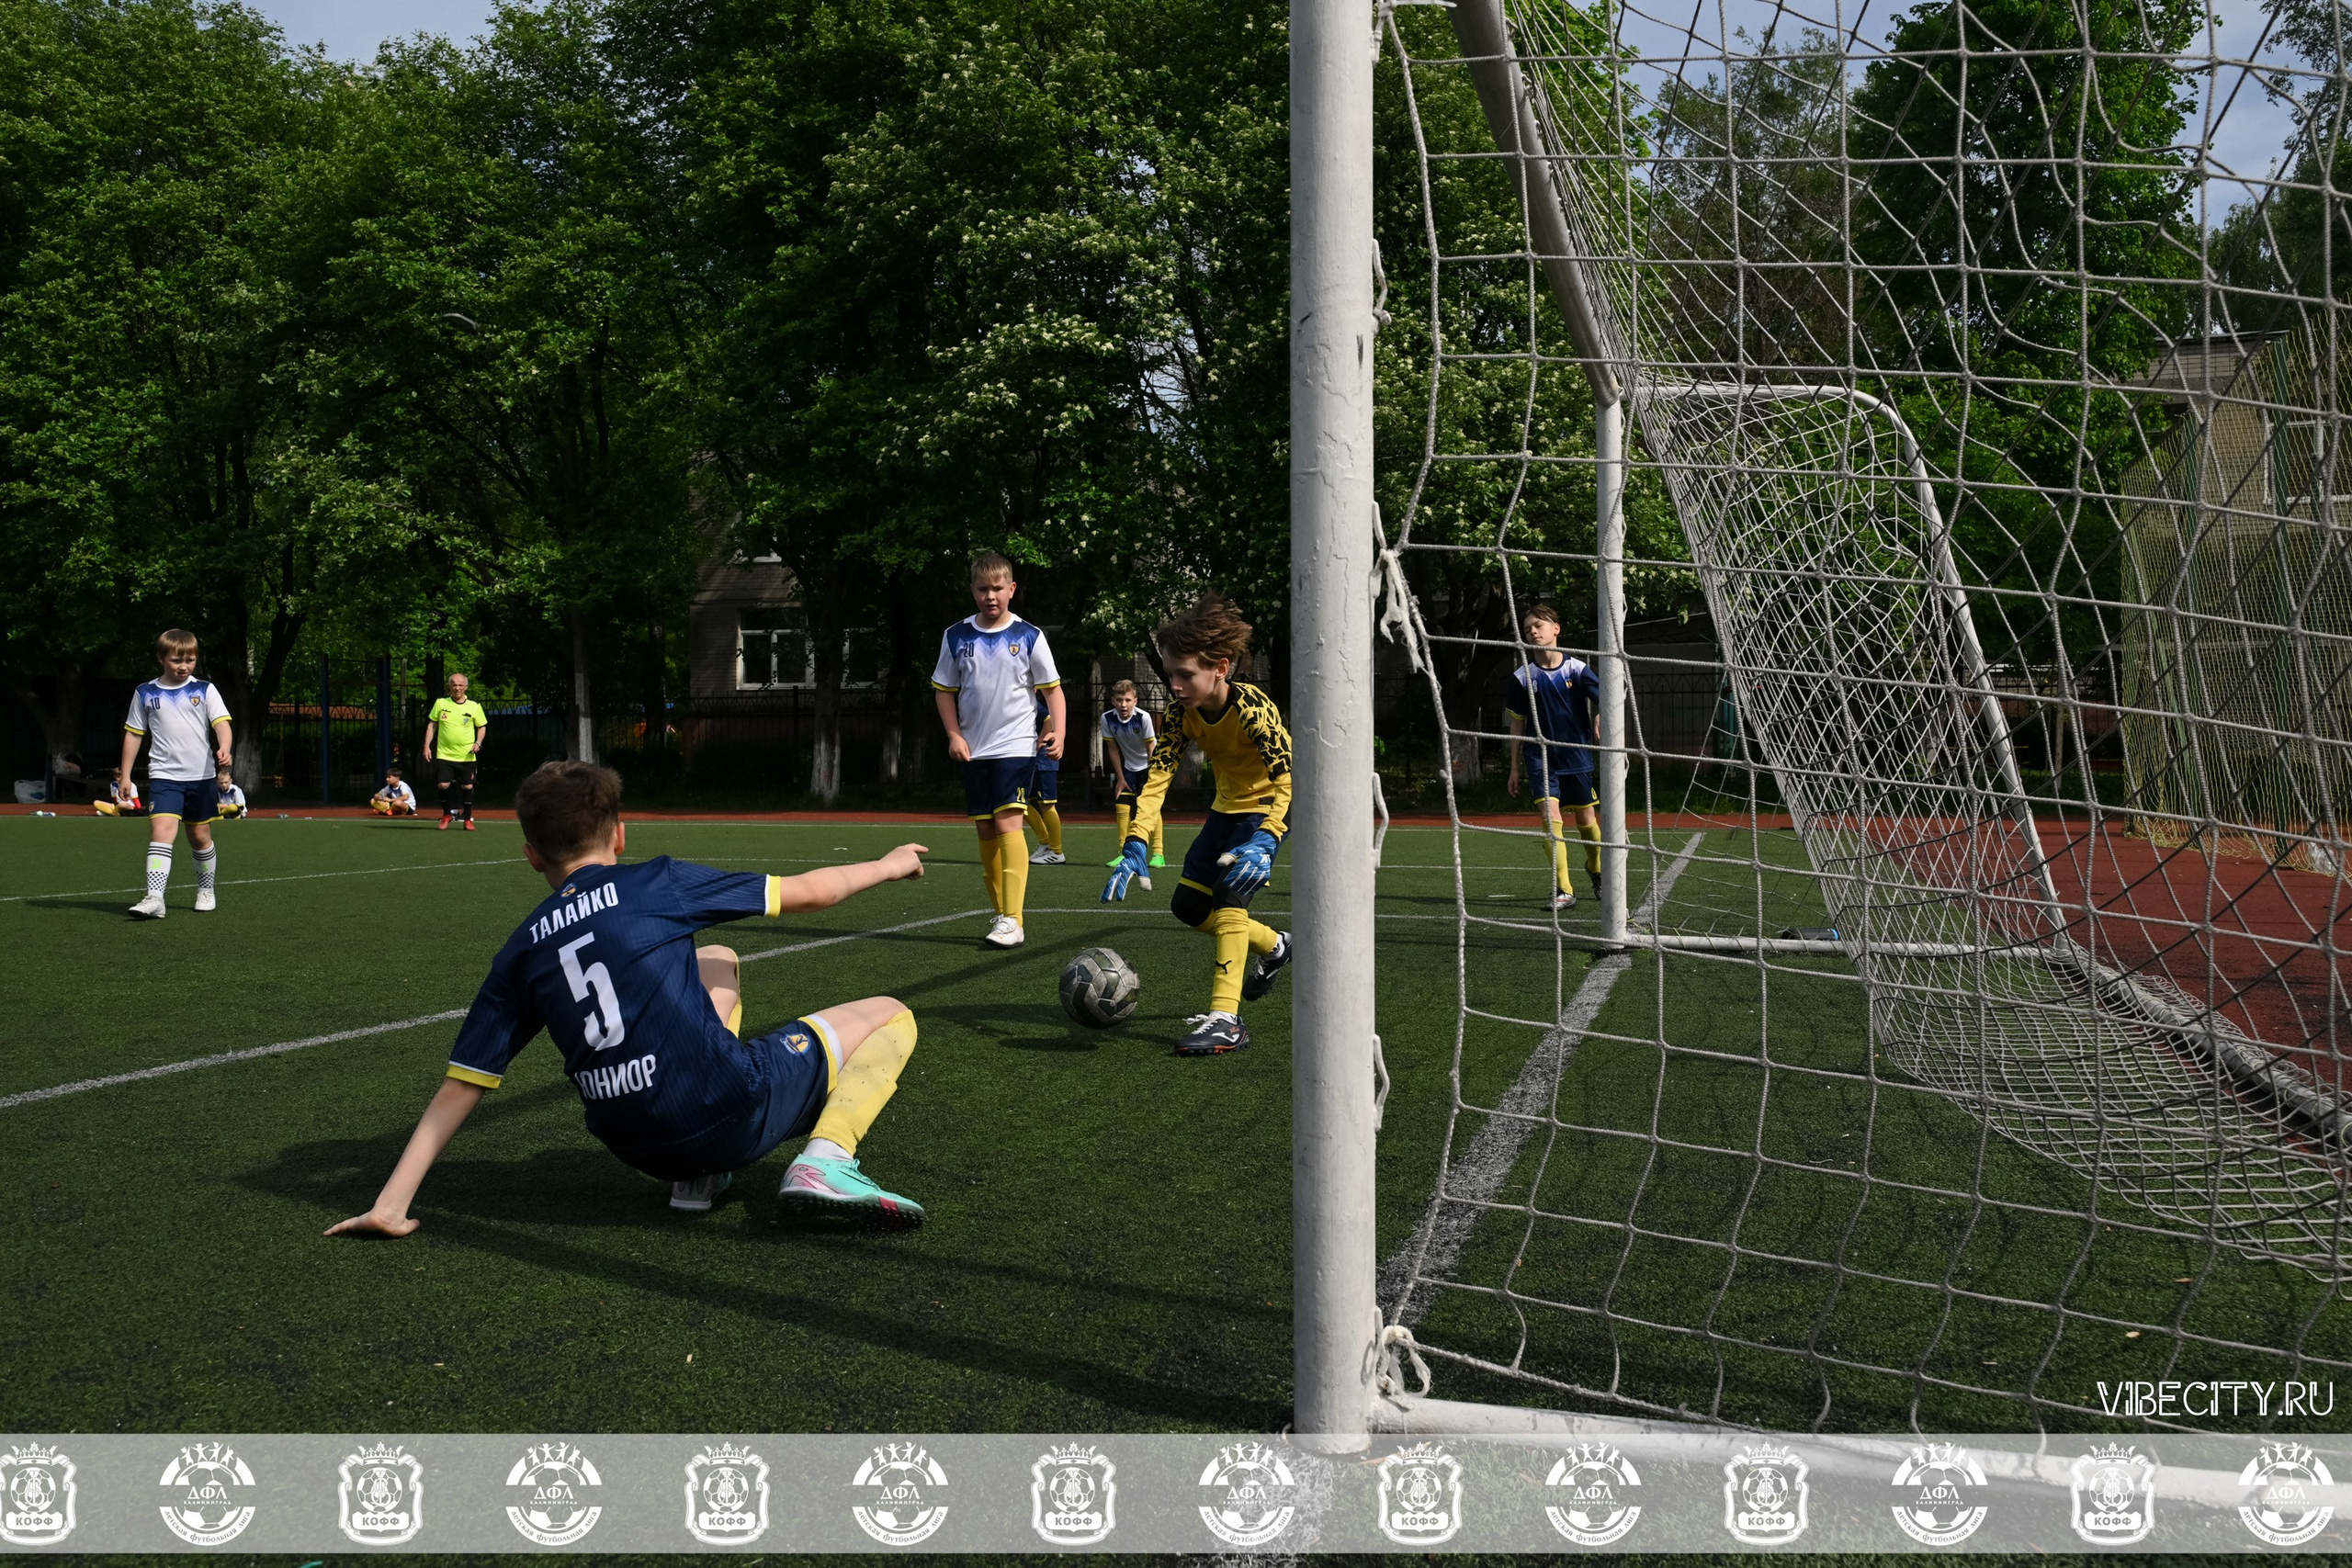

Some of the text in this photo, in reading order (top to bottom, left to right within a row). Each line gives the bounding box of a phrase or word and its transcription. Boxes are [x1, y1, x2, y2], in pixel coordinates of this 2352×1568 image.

[963, 642, 974, 658] 20
[151, 697, 161, 710] 10
[529, 882, 619, 944] ТАЛАЙКО
[558, 931, 625, 1052] 5
[574, 1054, 657, 1100] ЮНИОР
